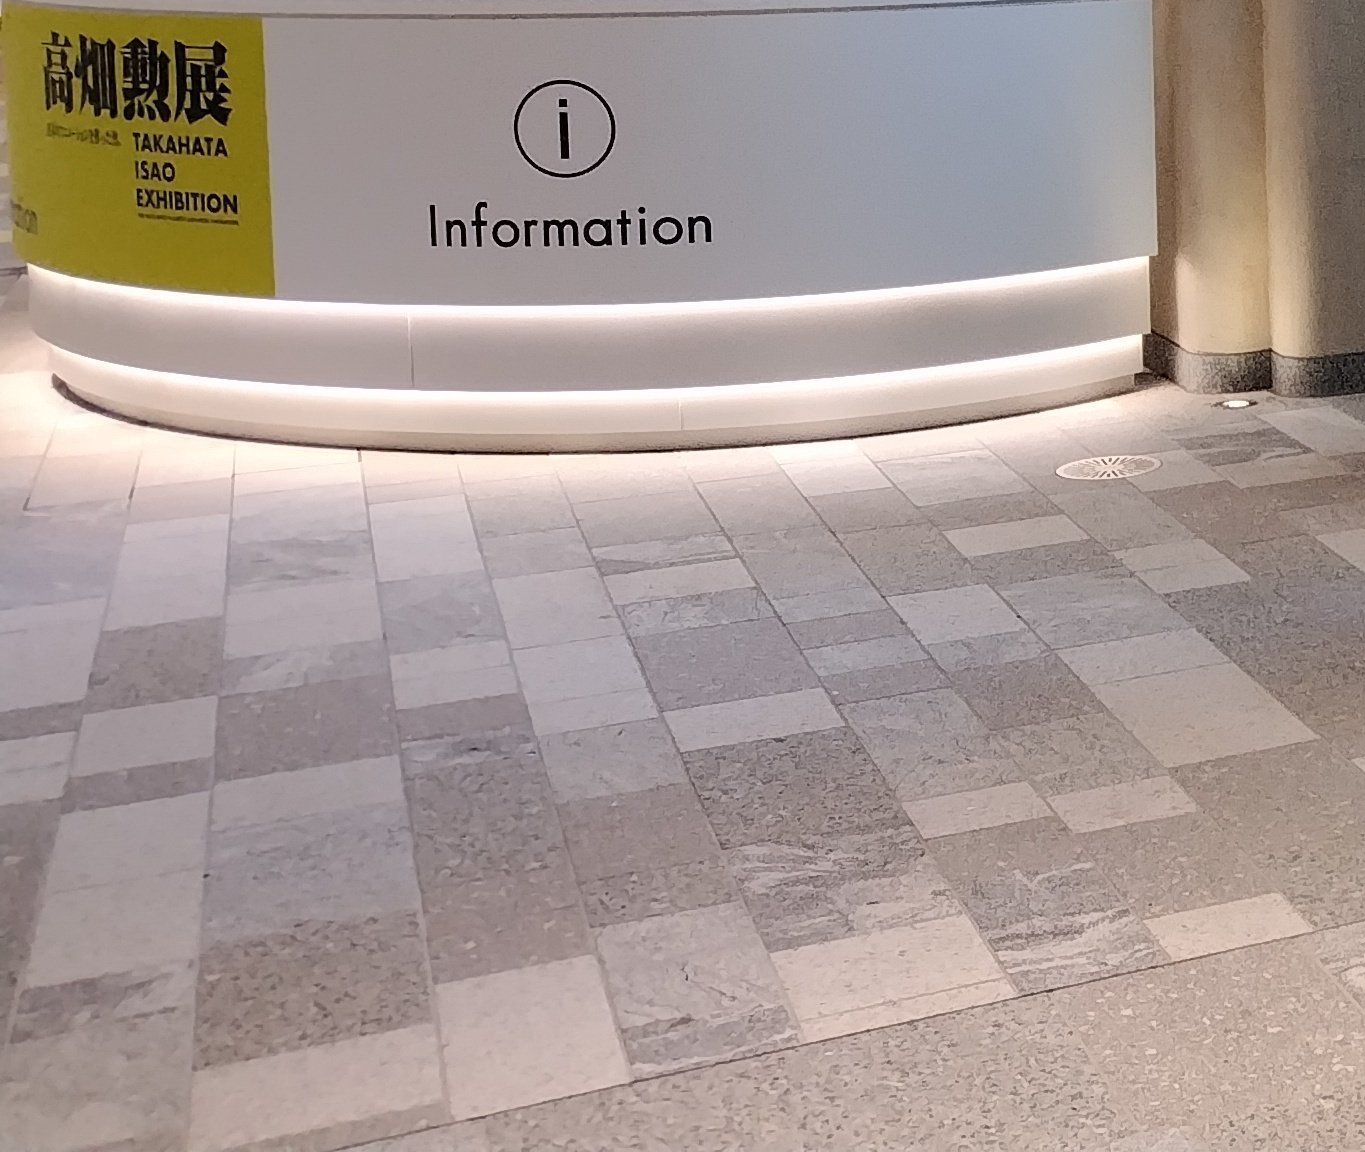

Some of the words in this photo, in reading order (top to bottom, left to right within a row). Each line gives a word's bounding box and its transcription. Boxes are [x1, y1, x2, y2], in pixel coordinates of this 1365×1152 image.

[41, 31, 232, 126] 高畑勲展
[132, 132, 228, 157] TAKAHATA
[135, 160, 176, 183] ISAO
[135, 188, 238, 214] EXHIBITION
[429, 201, 712, 248] Information
